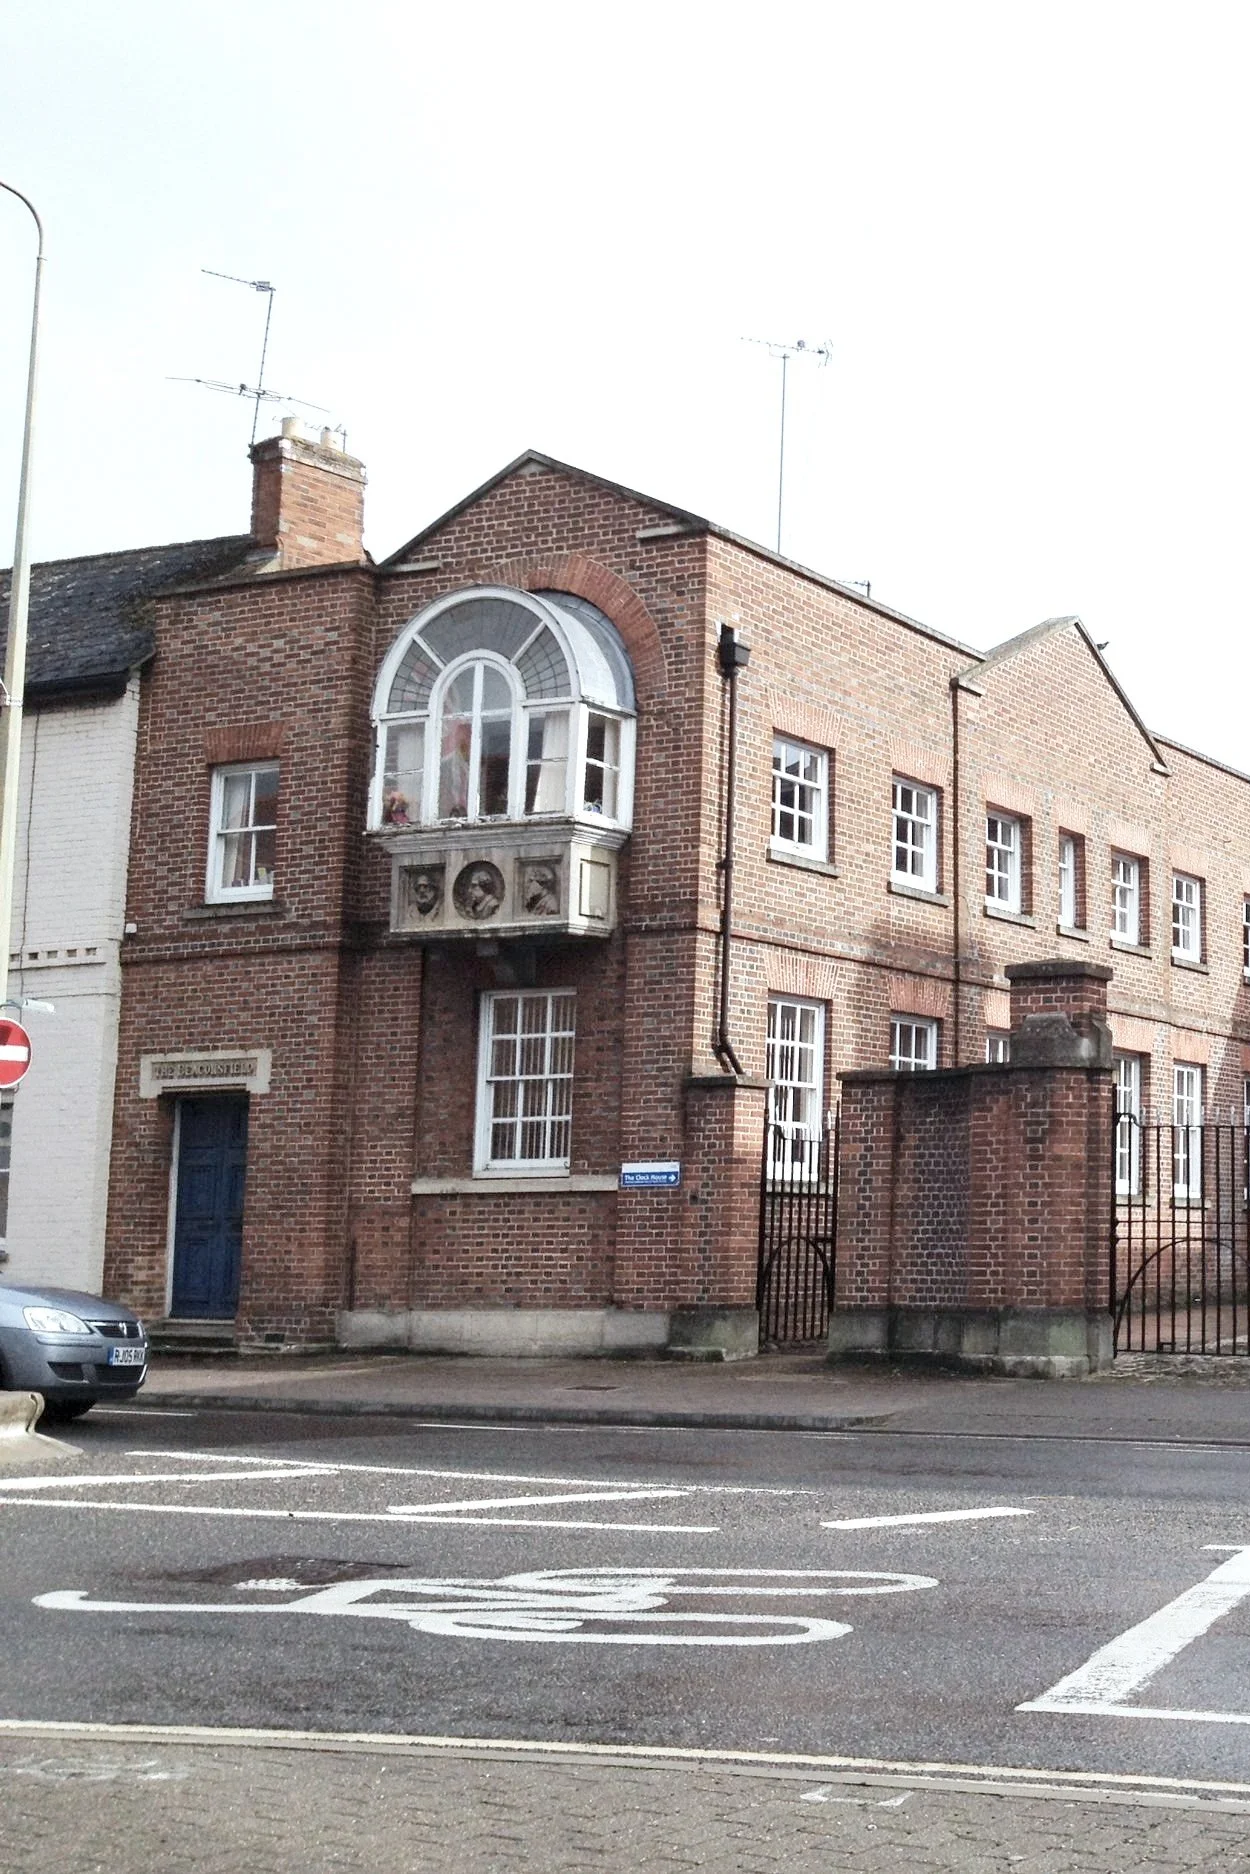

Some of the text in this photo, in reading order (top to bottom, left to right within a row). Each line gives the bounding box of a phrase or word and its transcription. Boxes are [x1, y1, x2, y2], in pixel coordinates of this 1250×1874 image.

[155, 1061, 255, 1079] THE BEACONSFIELD
[635, 1173, 649, 1181] Clock
[650, 1173, 667, 1181] House
